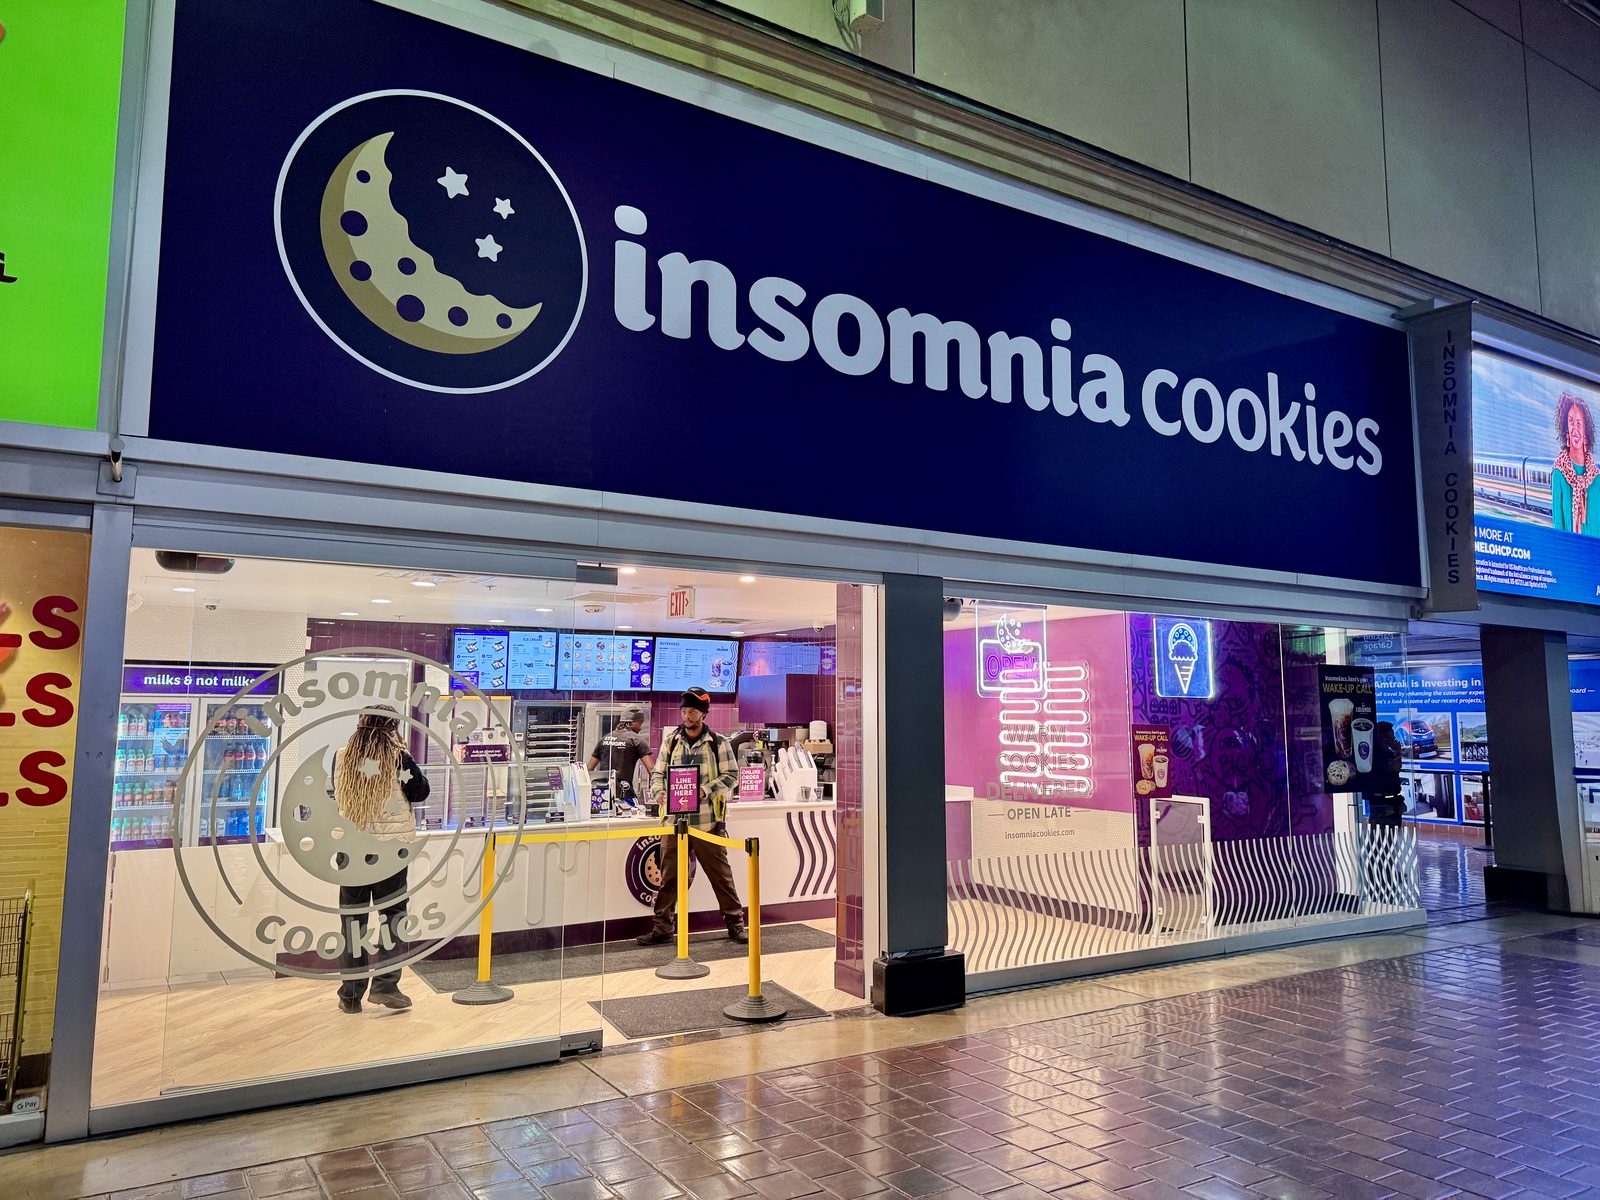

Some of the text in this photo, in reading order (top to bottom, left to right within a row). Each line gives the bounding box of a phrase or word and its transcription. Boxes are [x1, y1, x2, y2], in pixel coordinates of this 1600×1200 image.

[613, 204, 1383, 476] insomnia cookies
[1442, 329, 1460, 584] INSOMNIA COOKIES
[1479, 527, 1502, 541] MORE
[1504, 531, 1514, 543] AT
[670, 591, 686, 616] EXIT
[986, 654, 1036, 680] OPEN
[144, 674, 180, 686] milks
[184, 676, 192, 686] &
[196, 676, 218, 686] not
[1322, 682, 1373, 694] WAKE-UP CALL
[1411, 679, 1419, 688] is
[1422, 678, 1468, 688] Investing
[1471, 678, 1481, 686] in
[236, 670, 478, 744] insomnia
[1004, 724, 1067, 743] WARM
[998, 752, 1079, 772] COOKIES
[985, 780, 1091, 802] DELIVERED
[1007, 806, 1072, 820] OPEN LATE
[636, 835, 662, 852] inso
[1004, 828, 1075, 840] insomniacookies.com
[255, 902, 446, 960] cookies
